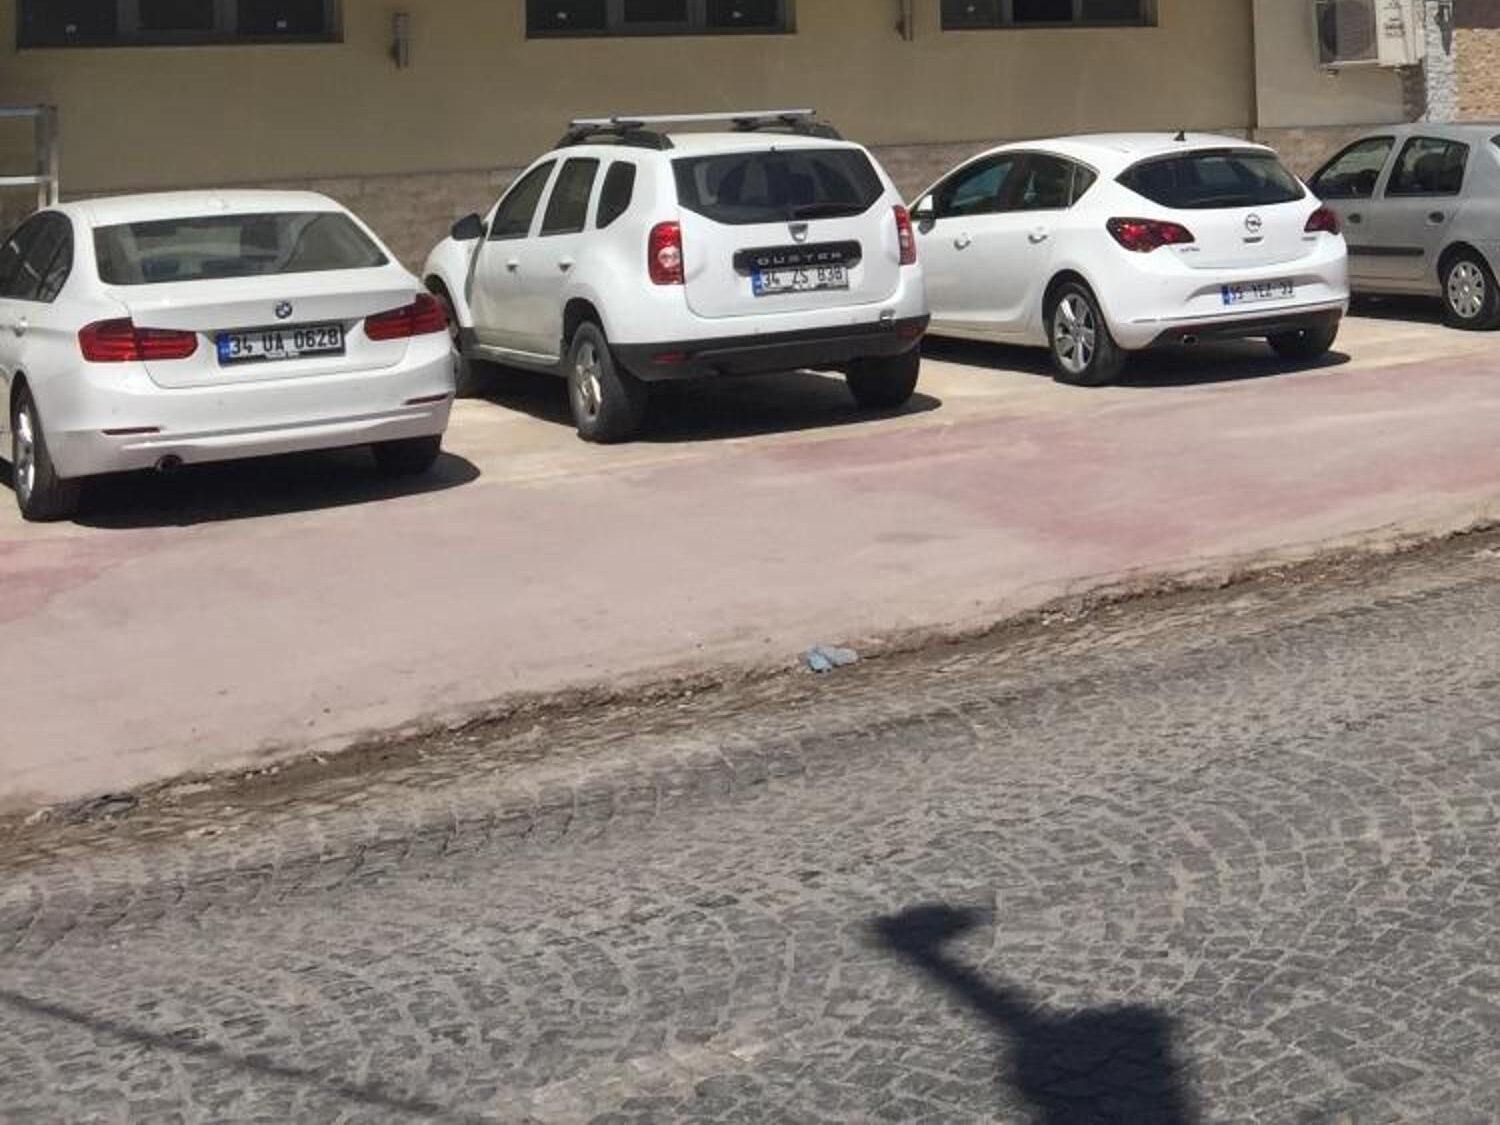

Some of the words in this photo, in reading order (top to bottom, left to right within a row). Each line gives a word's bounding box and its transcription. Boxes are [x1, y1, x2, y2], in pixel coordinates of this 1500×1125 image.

[229, 336, 253, 355] 34
[262, 334, 285, 352] UA
[294, 329, 339, 349] 0628
